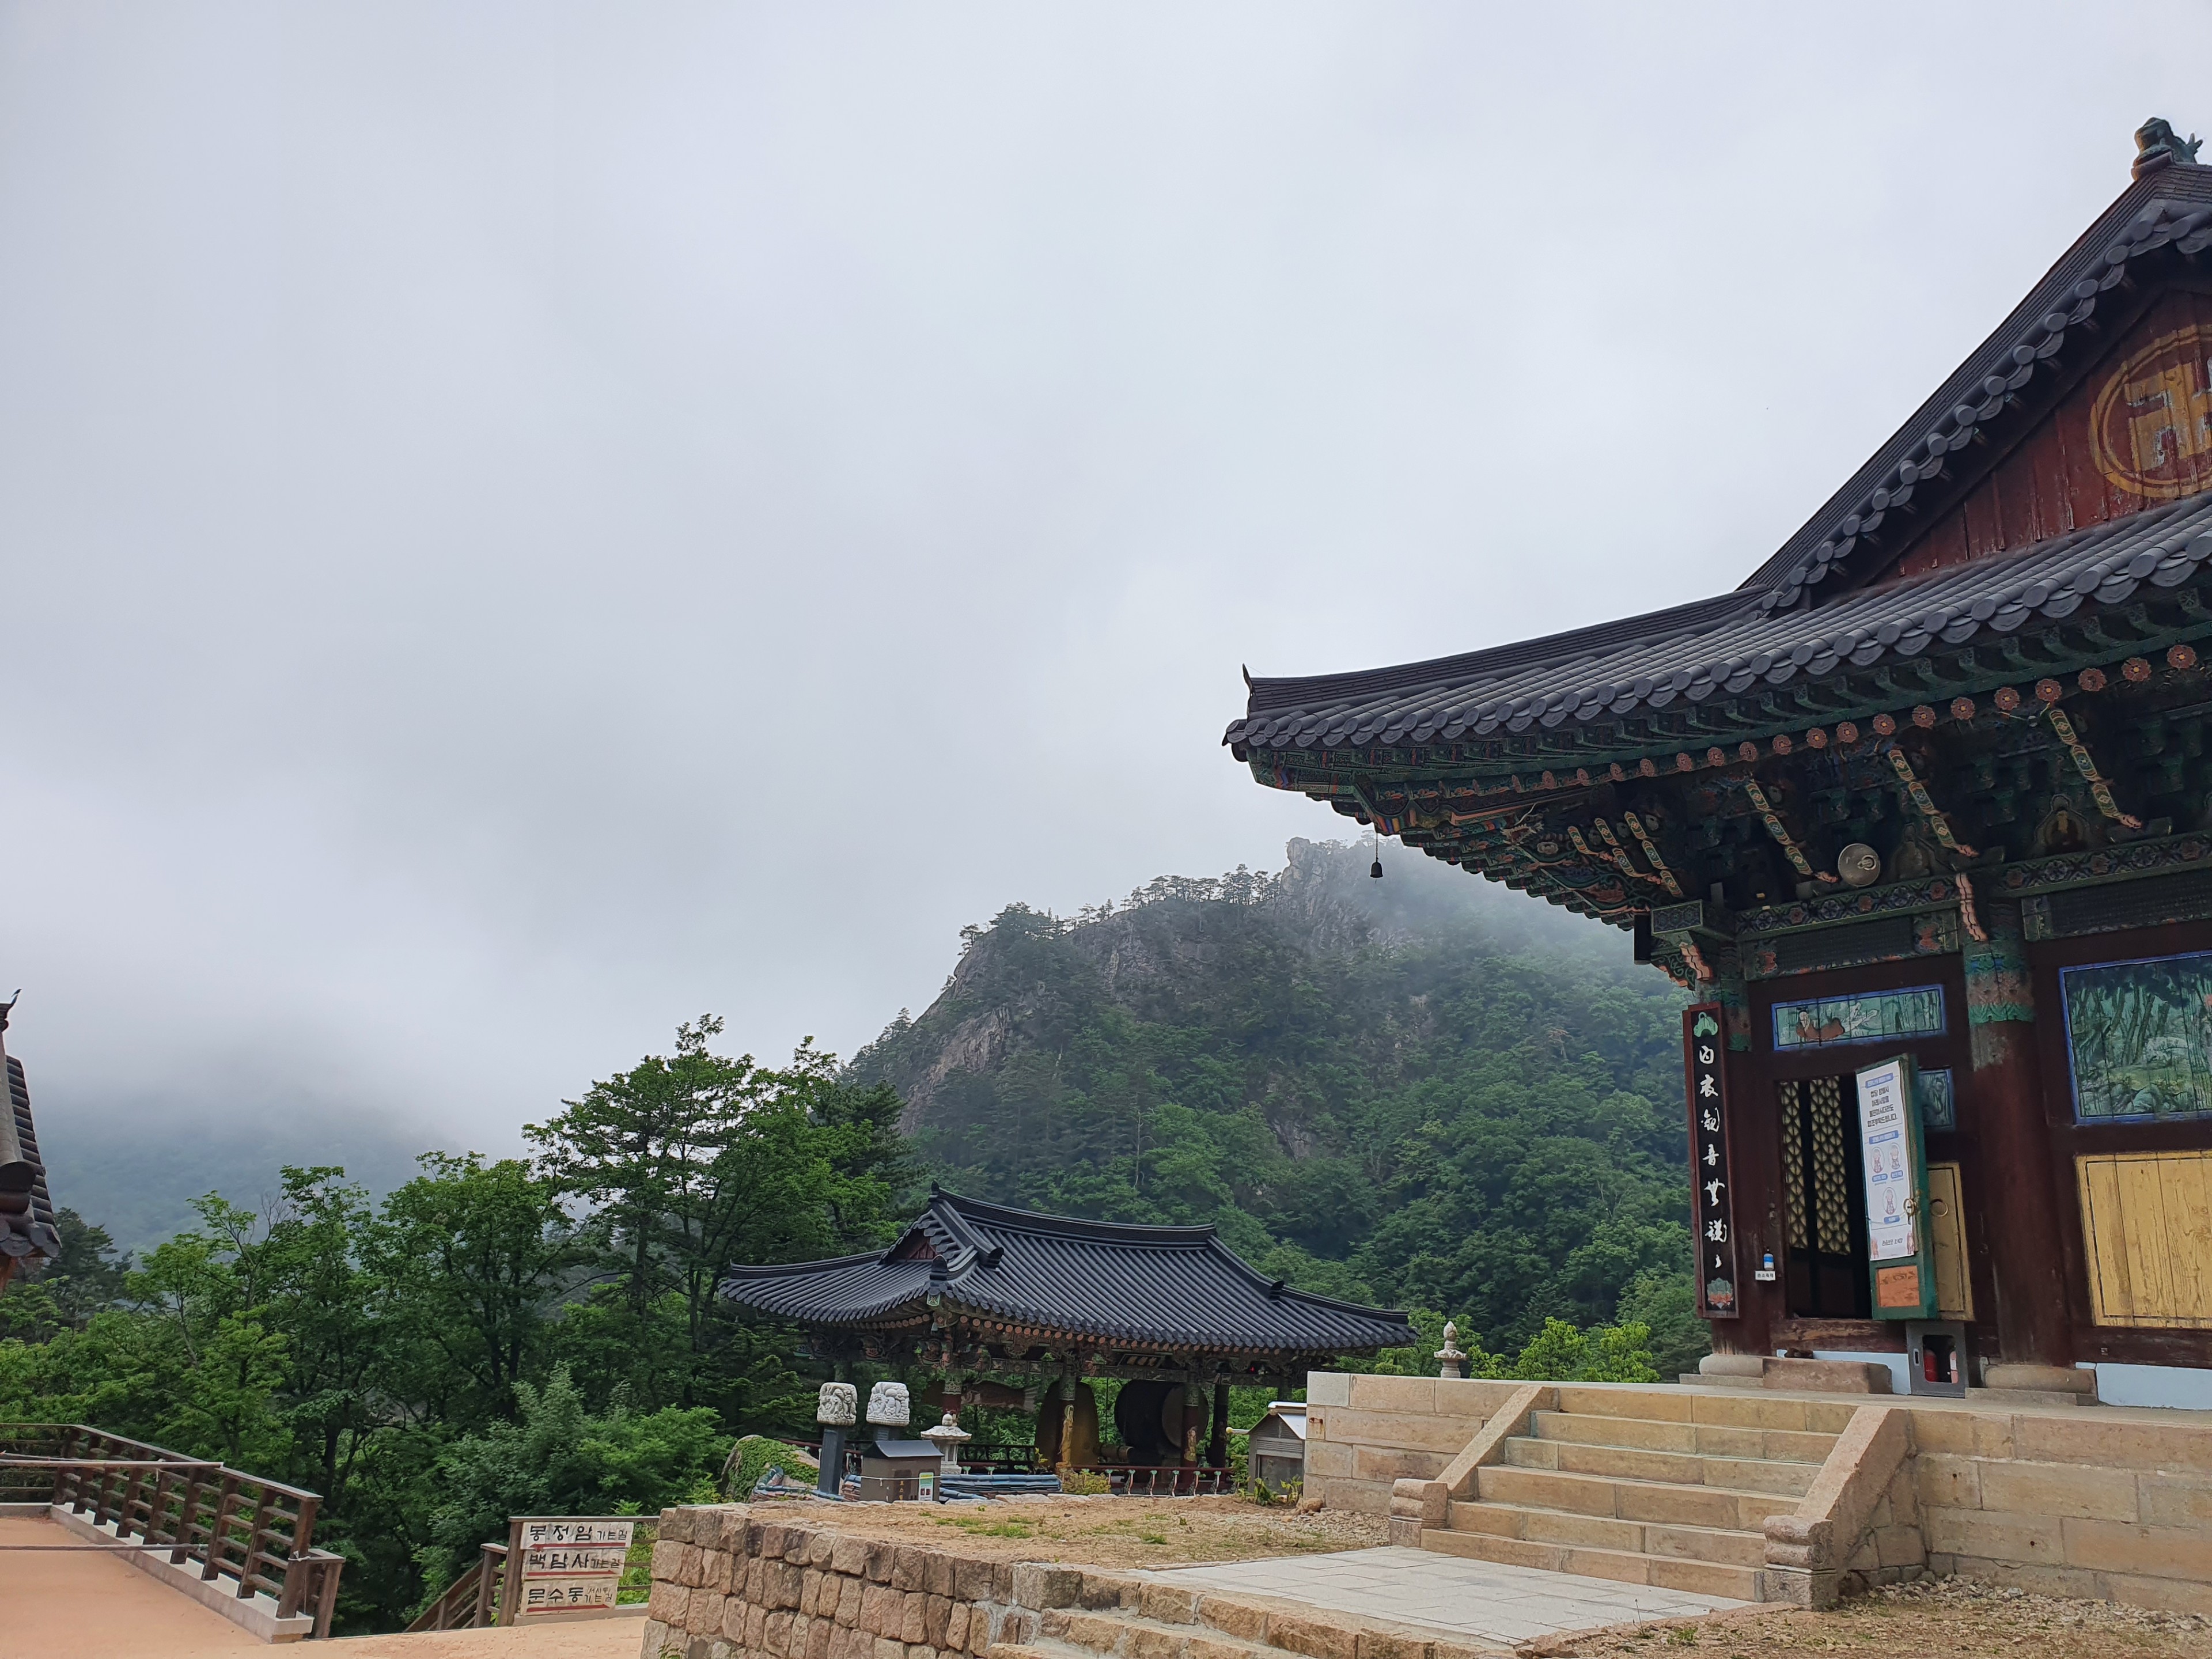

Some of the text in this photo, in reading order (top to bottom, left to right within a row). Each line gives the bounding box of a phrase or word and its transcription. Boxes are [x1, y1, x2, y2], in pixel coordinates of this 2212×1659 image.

[529, 1525, 628, 1541] 봉정암 가는길
[529, 1553, 589, 1569] 백담사
[528, 1586, 584, 1605] 문수동
